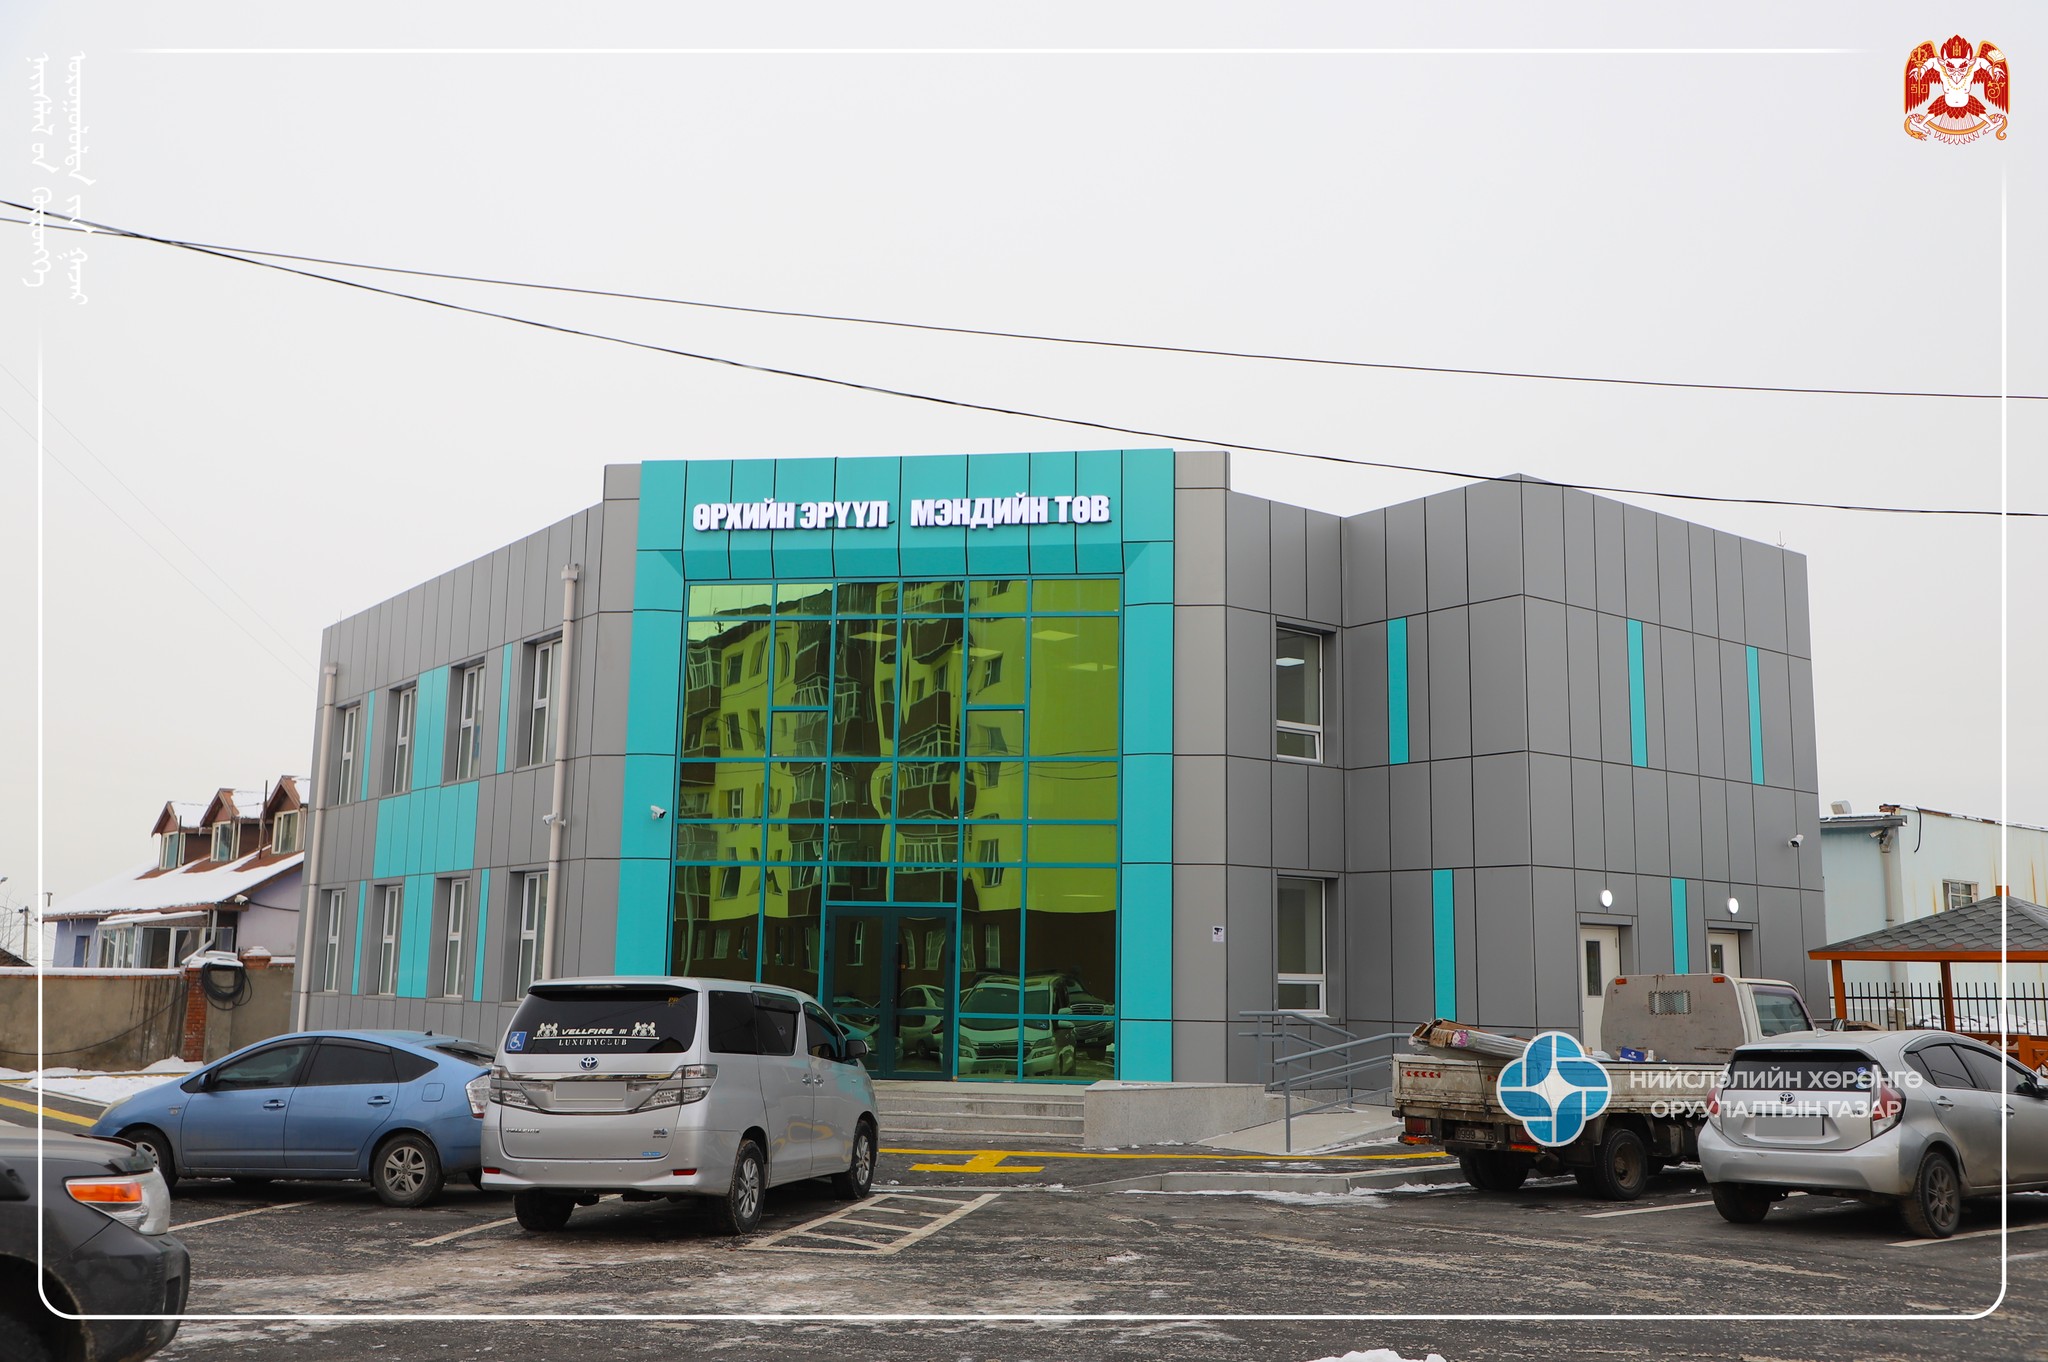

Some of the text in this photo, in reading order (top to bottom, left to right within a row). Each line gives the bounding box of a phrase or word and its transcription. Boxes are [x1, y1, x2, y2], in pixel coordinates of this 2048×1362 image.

[693, 492, 1110, 531] ӨРХИЙН ЭРҮҮЛ МЭНДИЙН ТӨВ
